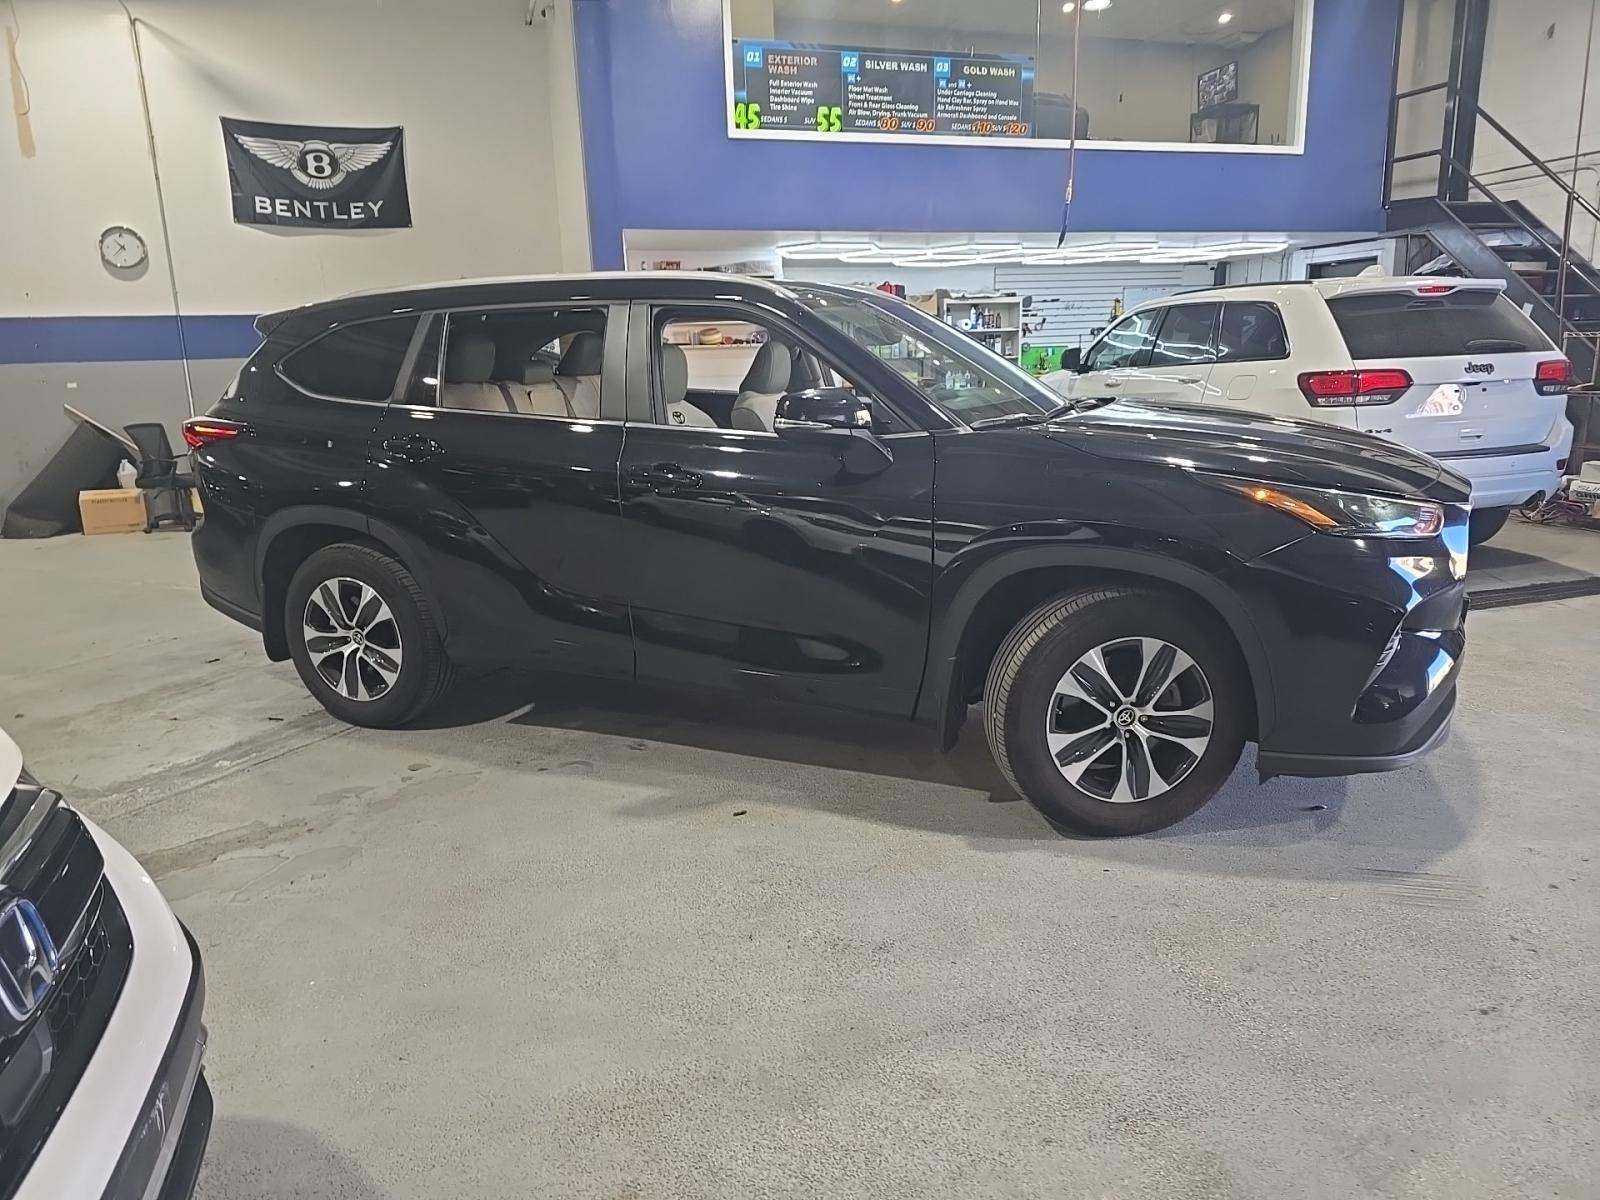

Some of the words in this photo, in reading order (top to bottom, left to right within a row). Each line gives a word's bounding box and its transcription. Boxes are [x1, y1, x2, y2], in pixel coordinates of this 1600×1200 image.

[746, 51, 760, 63] 01
[767, 54, 817, 66] EXTERIOR
[842, 56, 857, 68] 02
[768, 65, 798, 75] WASH
[865, 59, 899, 71] SILVER
[900, 62, 928, 73] WASH
[936, 62, 949, 73] 03
[963, 65, 988, 76] GOLD
[989, 67, 1016, 77] WASH
[769, 79, 780, 87] Full
[780, 80, 802, 88] Exterior
[803, 81, 818, 89] Wash
[848, 84, 862, 93] Floor
[769, 87, 790, 95] Interior
[937, 88, 953, 96] Under
[953, 89, 975, 98] Carriage
[975, 90, 998, 99] Cleaning
[769, 95, 800, 104] Dashboard
[801, 96, 815, 105] Wipe
[848, 92, 866, 101] Wheel
[866, 94, 893, 102] Treatment
[937, 96, 951, 104] Hand
[951, 96, 963, 105] Clay
[973, 97, 988, 106] Spray
[770, 103, 781, 111] Tire
[782, 104, 798, 112] Shine
[848, 100, 863, 109] Front
[896, 103, 919, 112] Cleaning
[937, 103, 945, 111] Air
[973, 105, 988, 114] Spray
[735, 103, 761, 129] 45
[761, 116, 783, 124] SEDANS
[804, 117, 817, 125] SUV
[817, 106, 842, 132] 55
[907, 111, 928, 119] Vacuum
[998, 113, 1018, 121] Console
[855, 119, 876, 127] SEDANS
[901, 120, 913, 129] SUV
[951, 123, 972, 131] SEDANS
[254, 195, 384, 220] BENTLEY
[1464, 362, 1495, 375] Jeep
